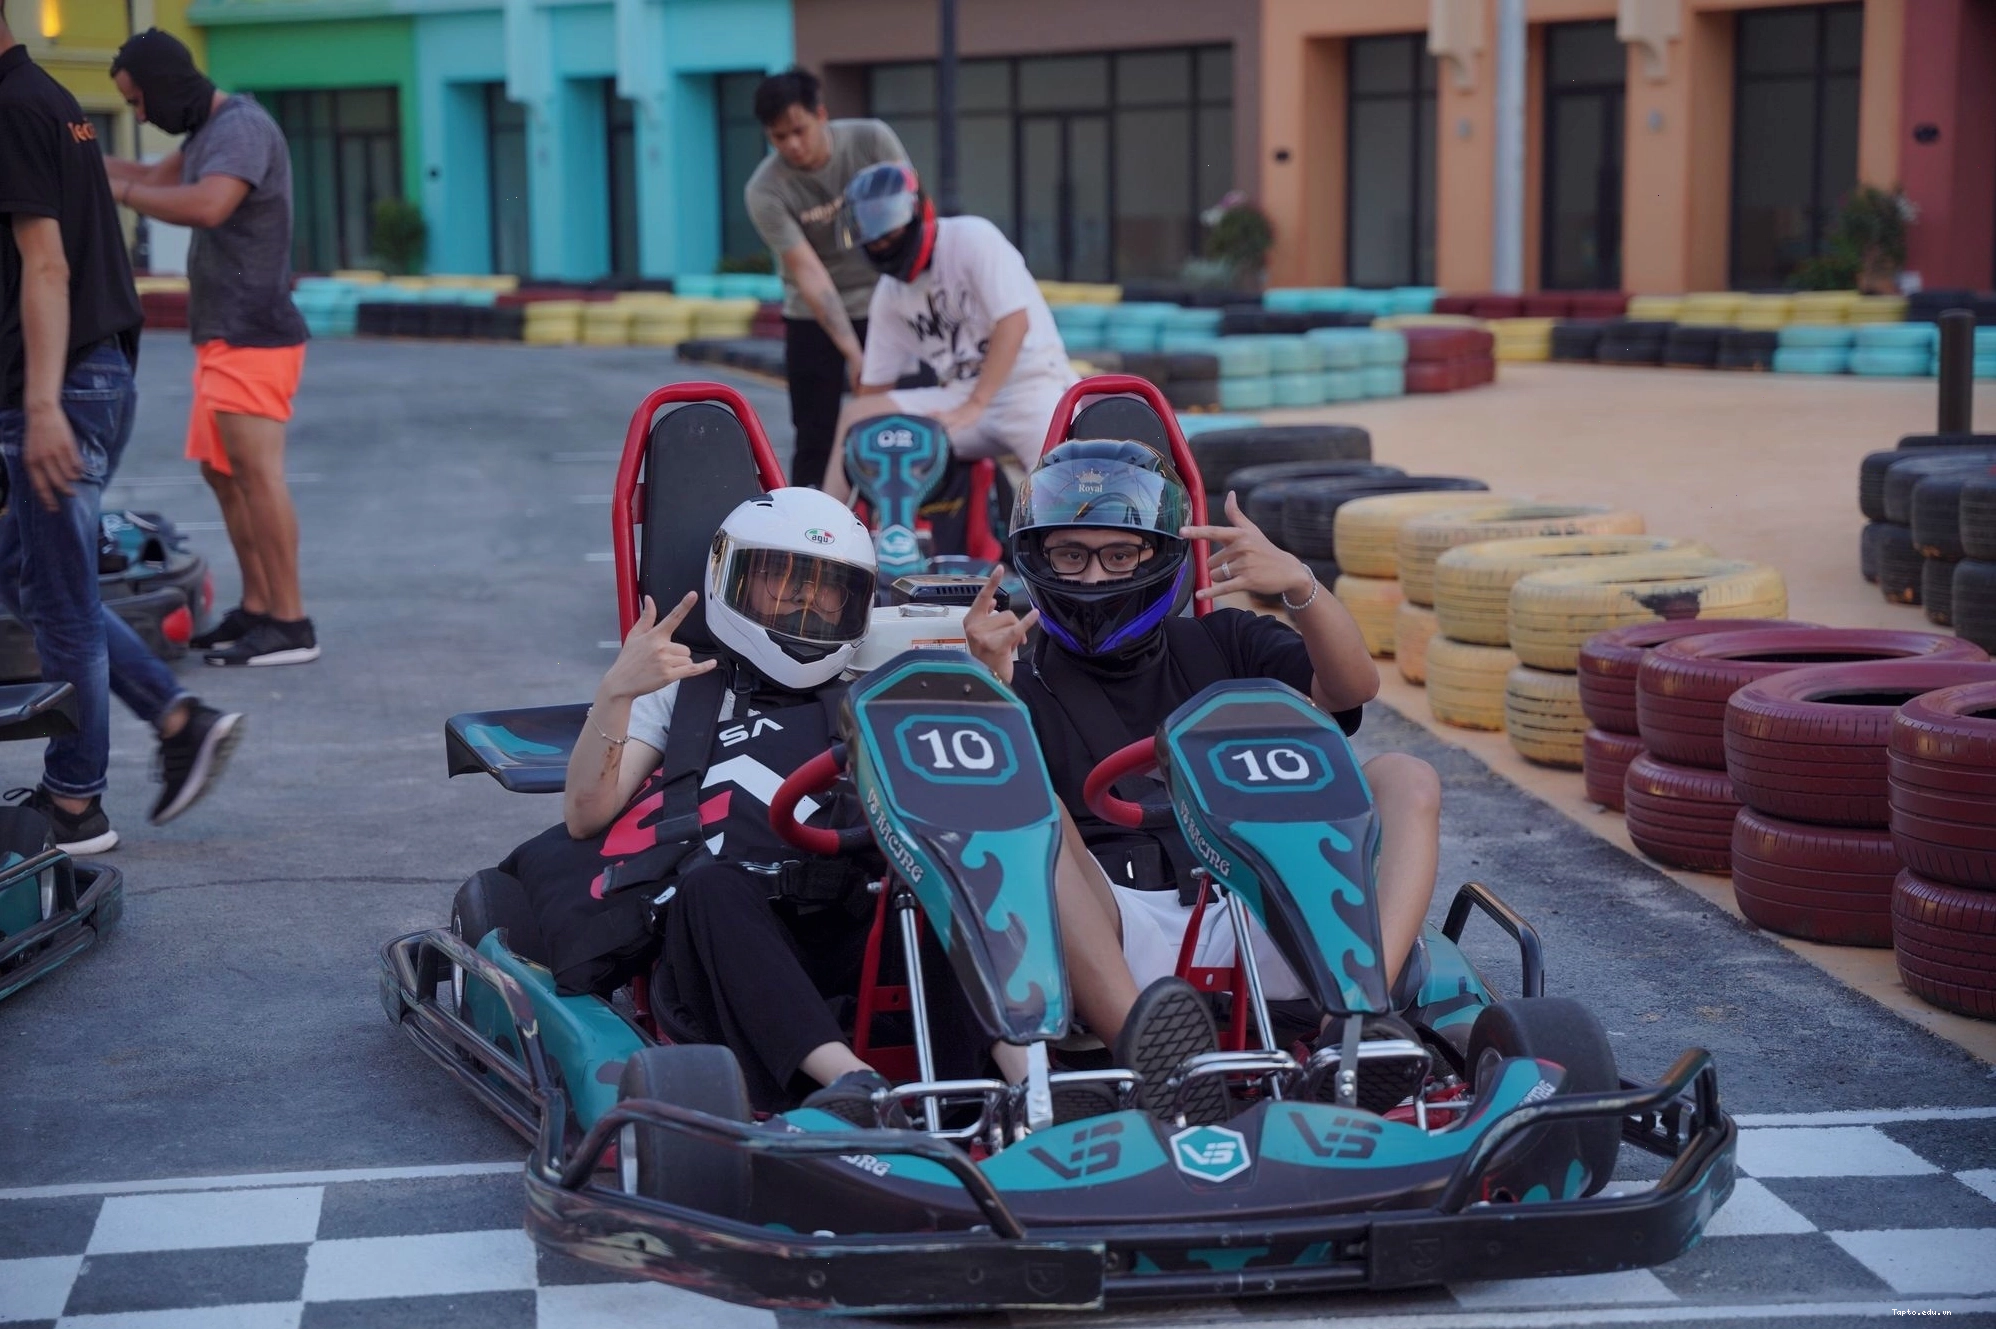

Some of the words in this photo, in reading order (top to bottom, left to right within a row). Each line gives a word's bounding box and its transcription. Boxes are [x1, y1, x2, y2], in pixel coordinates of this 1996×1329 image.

[1078, 483, 1103, 495] Royal
[917, 728, 995, 770] 10
[1230, 748, 1310, 781] 10
[1181, 1141, 1237, 1165] VS
